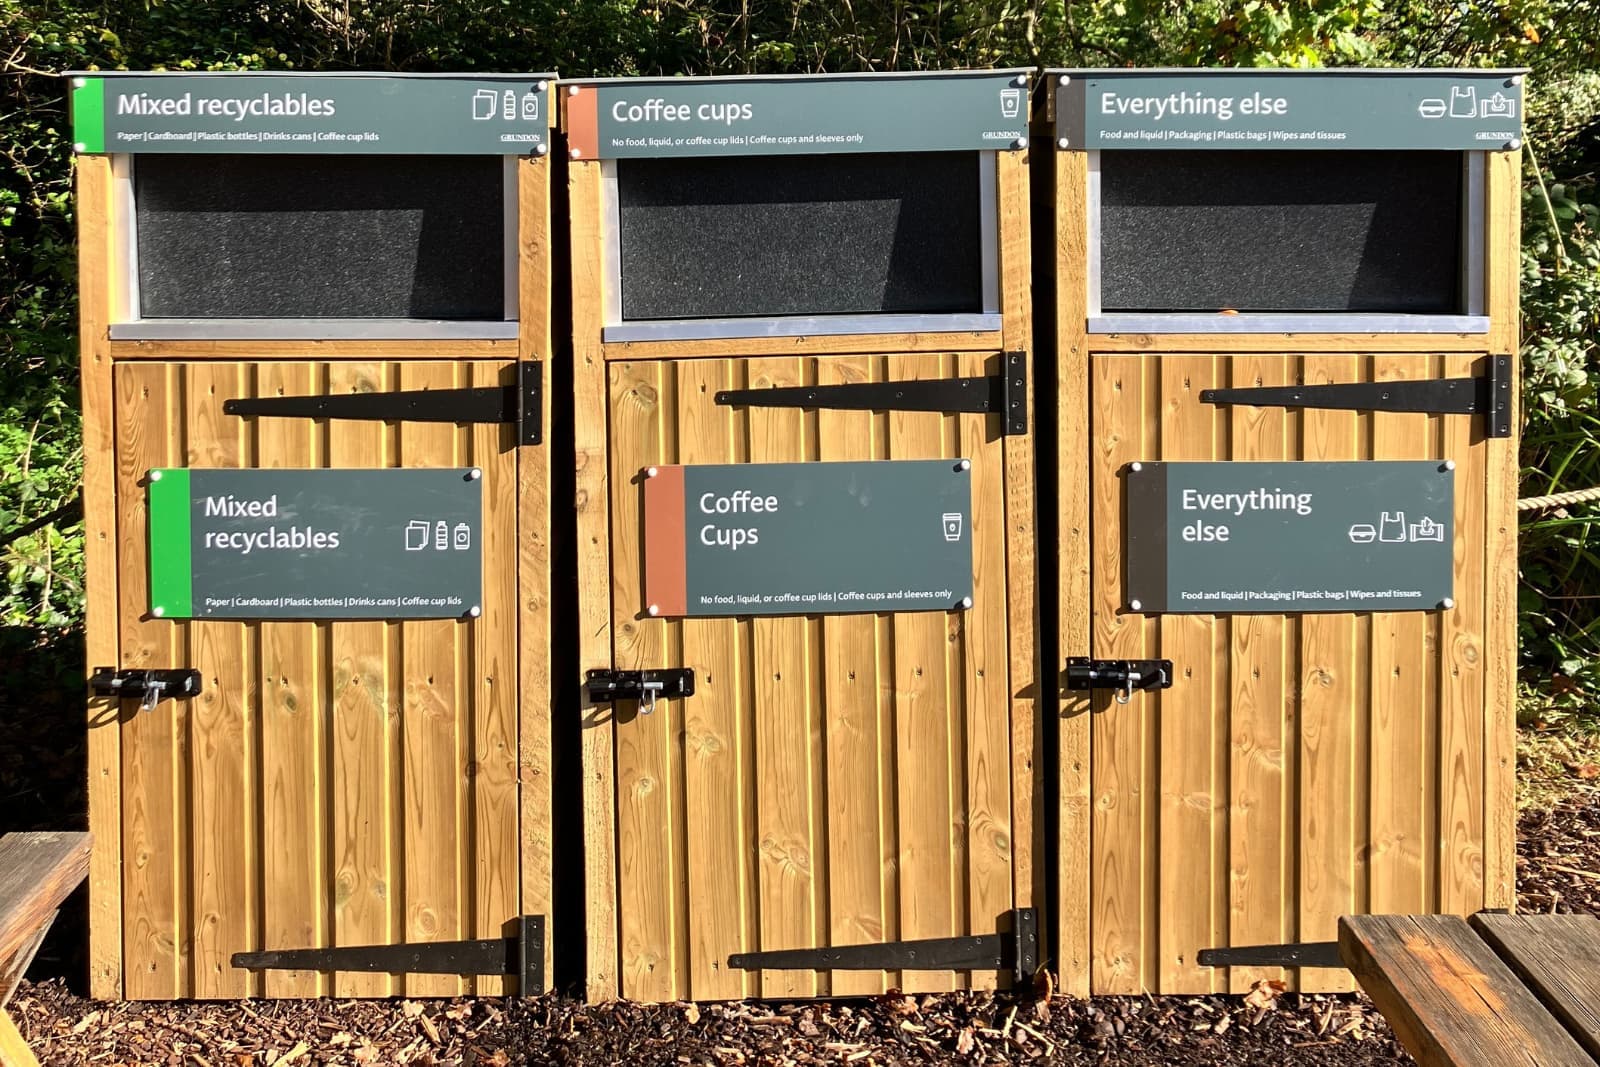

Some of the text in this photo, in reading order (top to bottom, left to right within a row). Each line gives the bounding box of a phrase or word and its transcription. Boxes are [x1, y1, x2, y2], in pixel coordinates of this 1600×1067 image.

[117, 92, 336, 121] Mixed recyclables
[612, 99, 753, 126] Coffee cups
[1101, 91, 1288, 121] Everything else
[117, 131, 380, 143] Paper Cardboard Plastic bottles Drinks cans Coffee cup lids
[500, 133, 541, 142] GRUNDON
[612, 138, 625, 147] No
[625, 137, 648, 147] food,
[648, 136, 674, 148] liquid,
[685, 136, 712, 145] coffee
[712, 137, 729, 147] cup
[729, 135, 745, 145] lids
[749, 135, 777, 145] Coffee
[777, 135, 798, 145] cups
[798, 134, 814, 143] and
[815, 133, 845, 143] sleeves
[845, 133, 864, 144] only
[982, 131, 1022, 141] GRUNDON
[1100, 130, 1347, 142] Food and liquid Packaging Plastic bags Wipes and tissues
[1475, 132, 1515, 141] GRUNDON
[204, 494, 278, 518] Mixed
[699, 490, 779, 514] Coffee
[1181, 487, 1313, 516] Everything
[205, 525, 340, 555] recyclables
[700, 524, 759, 551] Cups
[1181, 519, 1230, 542] else
[205, 595, 463, 608] Paper Cardboard Plastic bottles Drinks cans Coffee cup lids
[700, 588, 953, 605] No food, liquid, or coffee cup lids Coffee cups and sleeves only
[1181, 589, 1423, 602] Food and liquid Packaging Plastic bags Wipes and tissues
